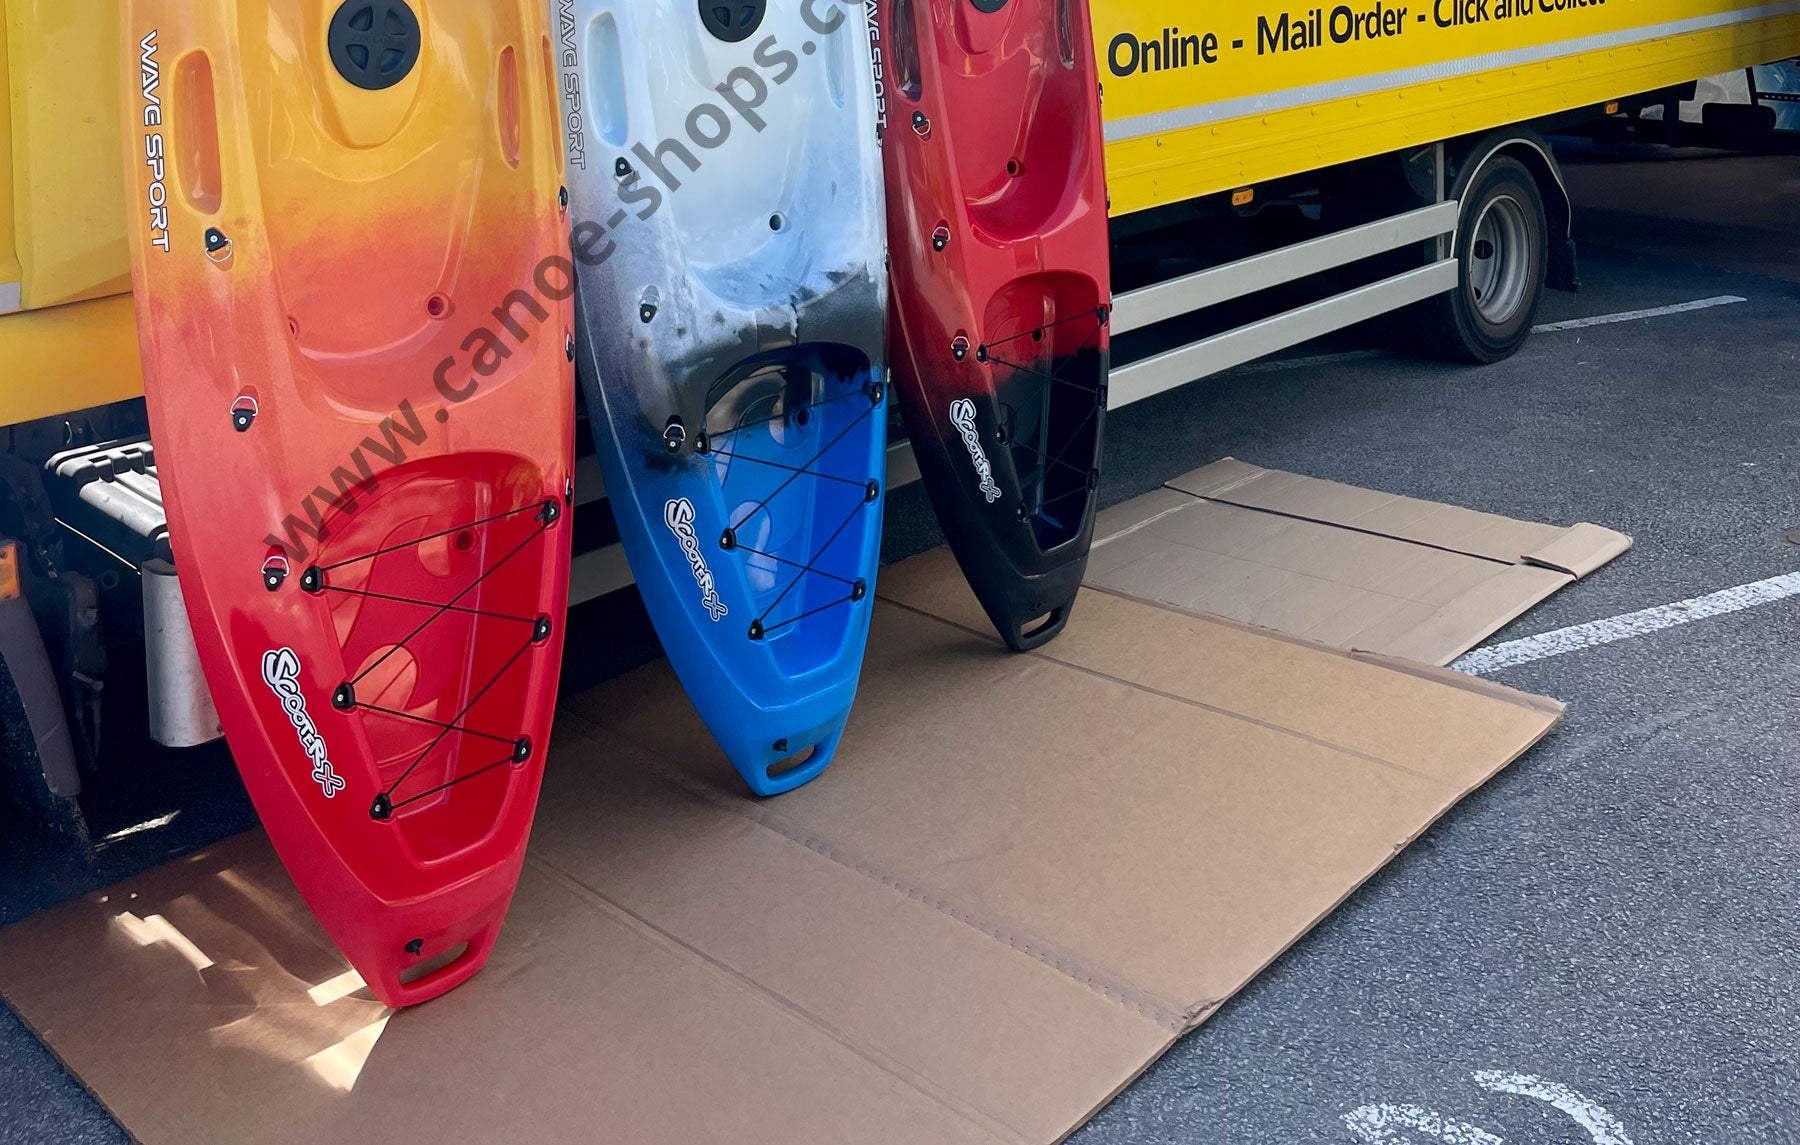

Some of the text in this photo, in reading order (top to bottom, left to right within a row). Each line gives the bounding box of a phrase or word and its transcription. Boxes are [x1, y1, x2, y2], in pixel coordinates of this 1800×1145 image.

[1107, 27, 1219, 77] Online
[1256, 9, 1322, 56] Mail
[1329, 1, 1408, 44] Order
[140, 29, 171, 253] WAVE SPORT
[563, 72, 586, 171] SPORT
